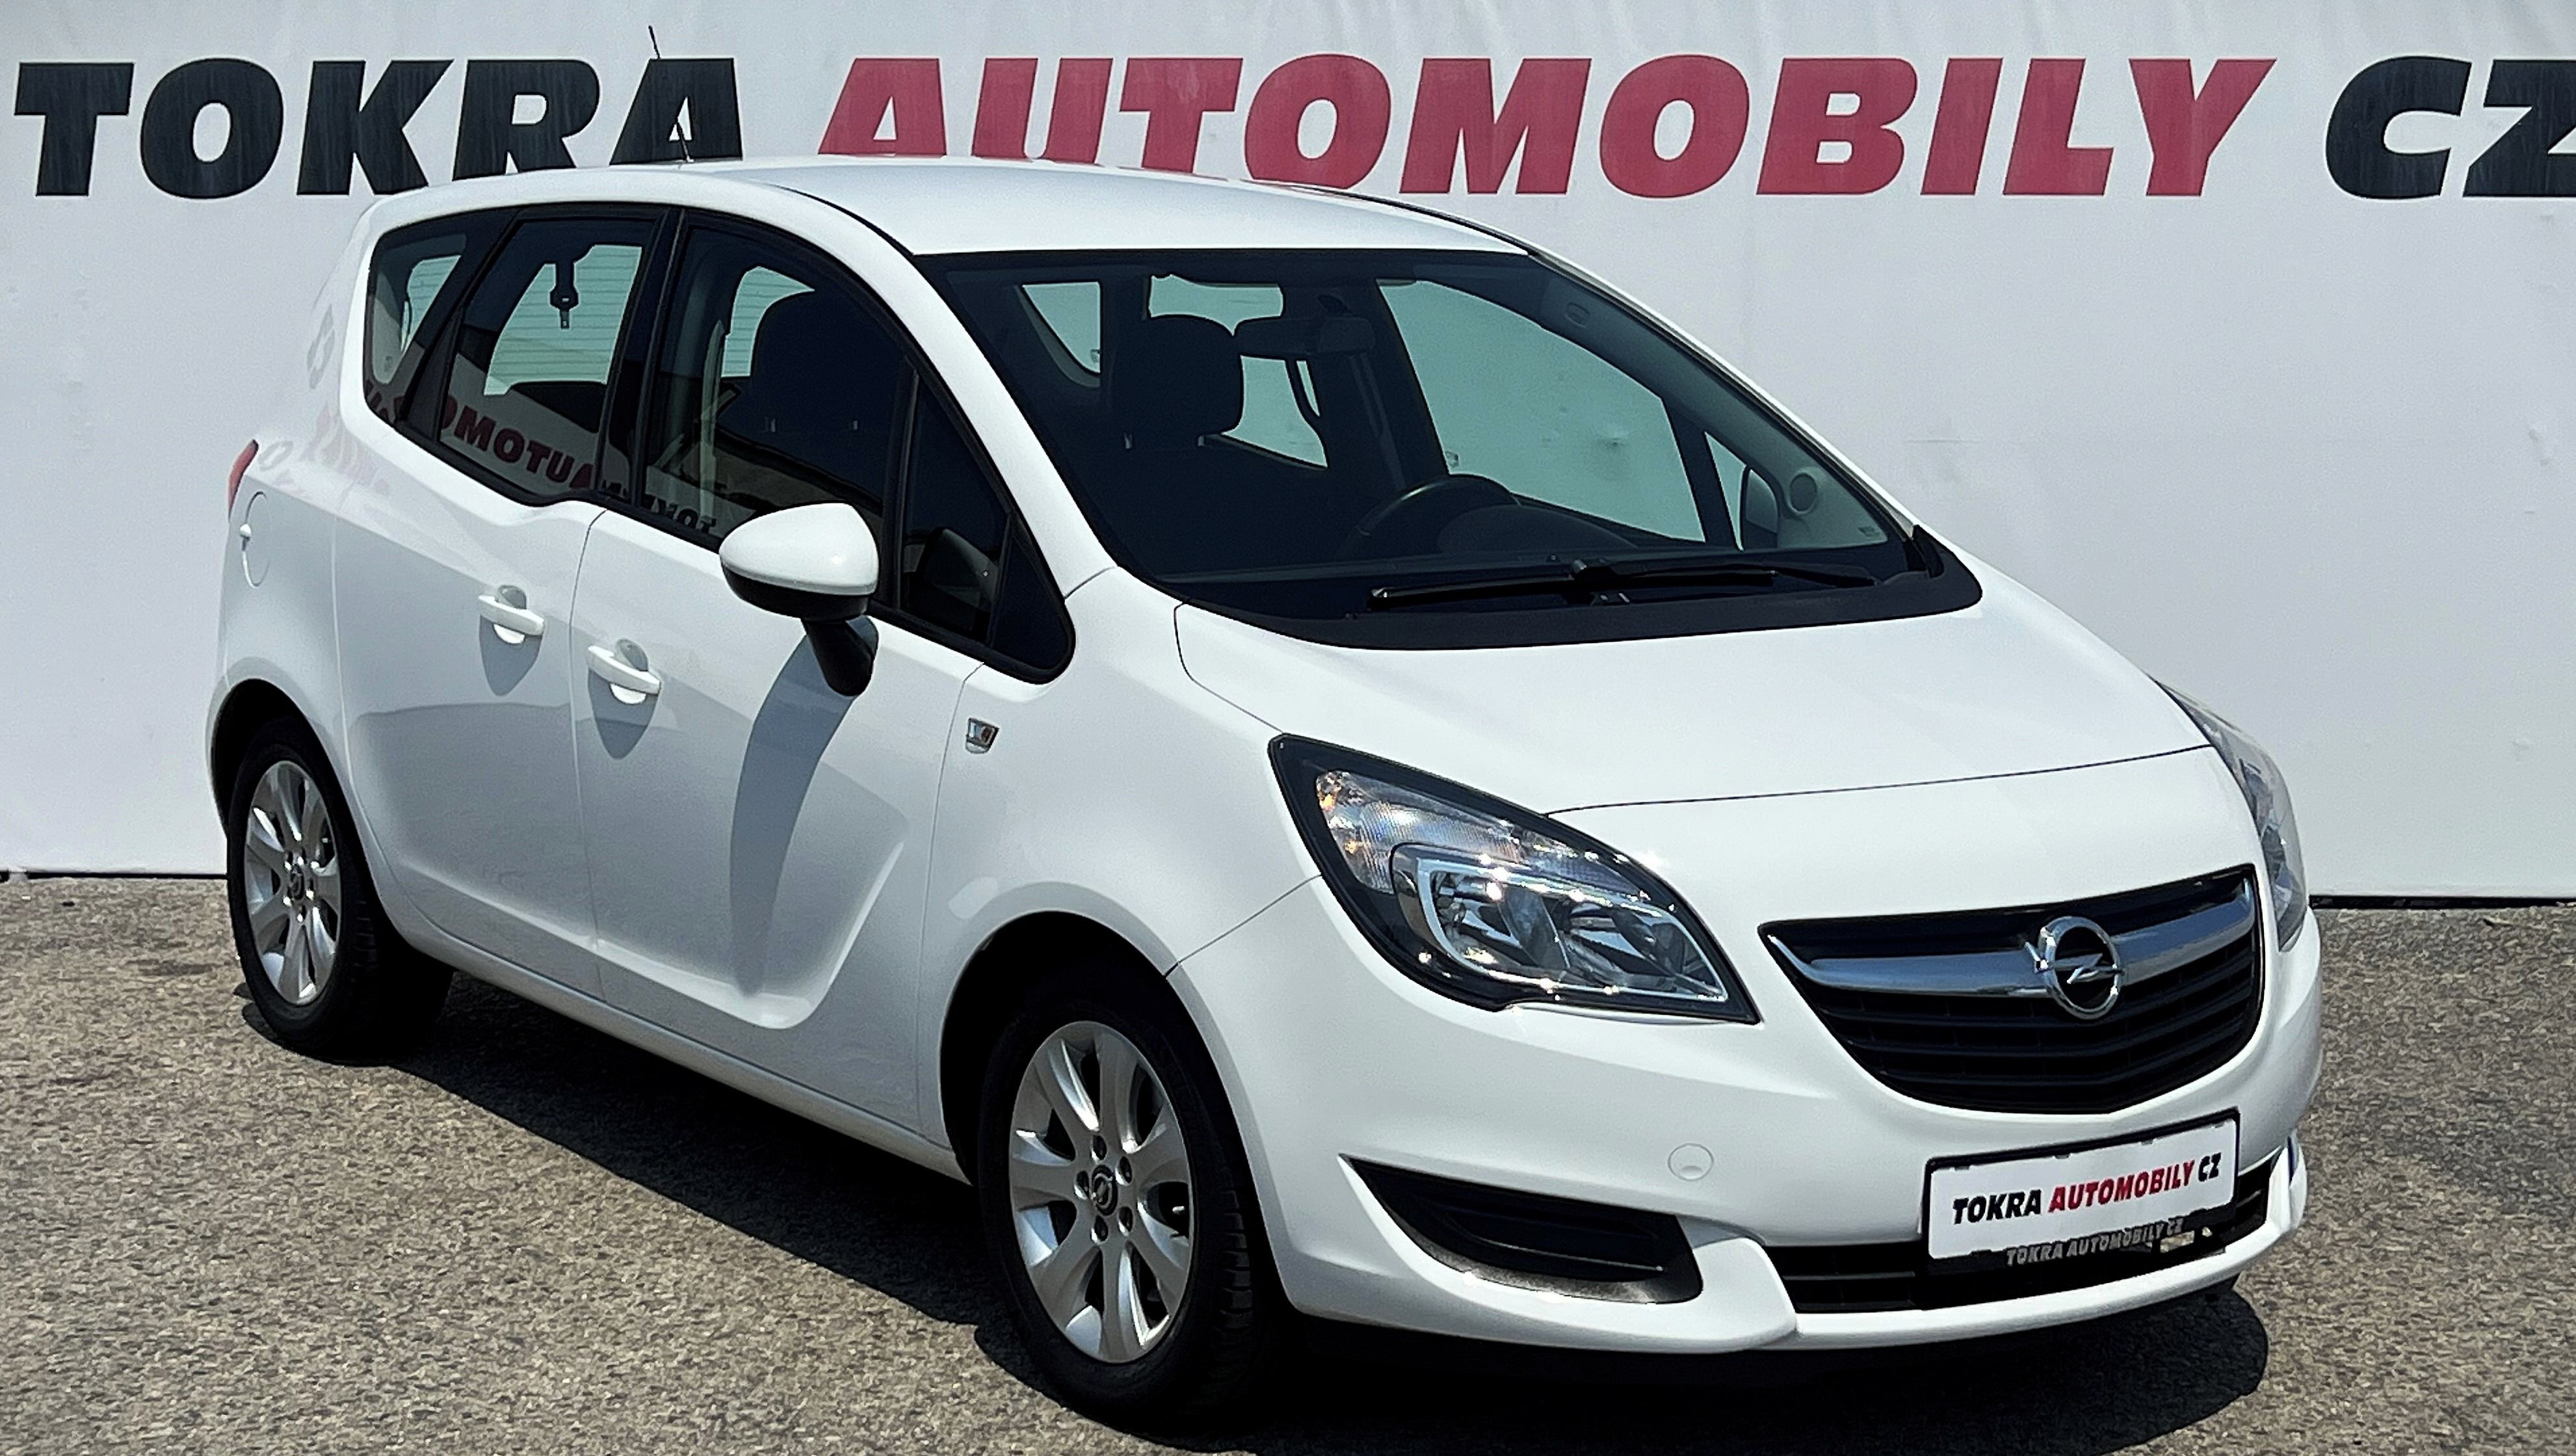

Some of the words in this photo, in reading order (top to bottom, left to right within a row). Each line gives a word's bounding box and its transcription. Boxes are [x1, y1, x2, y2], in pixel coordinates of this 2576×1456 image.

[14, 57, 743, 199] TOKRA
[817, 53, 2276, 198] AUTOMOBILY
[2325, 55, 2576, 200] CZ
[1952, 1189, 2042, 1224] TOKRA
[2047, 1159, 2196, 1213] AUTOMOBILY
[2198, 1152, 2222, 1182] CZ
[2006, 1244, 2064, 1266] TOKRA
[2066, 1223, 2166, 1257] AUTOMOBILY
[2166, 1217, 2183, 1236] CZ
